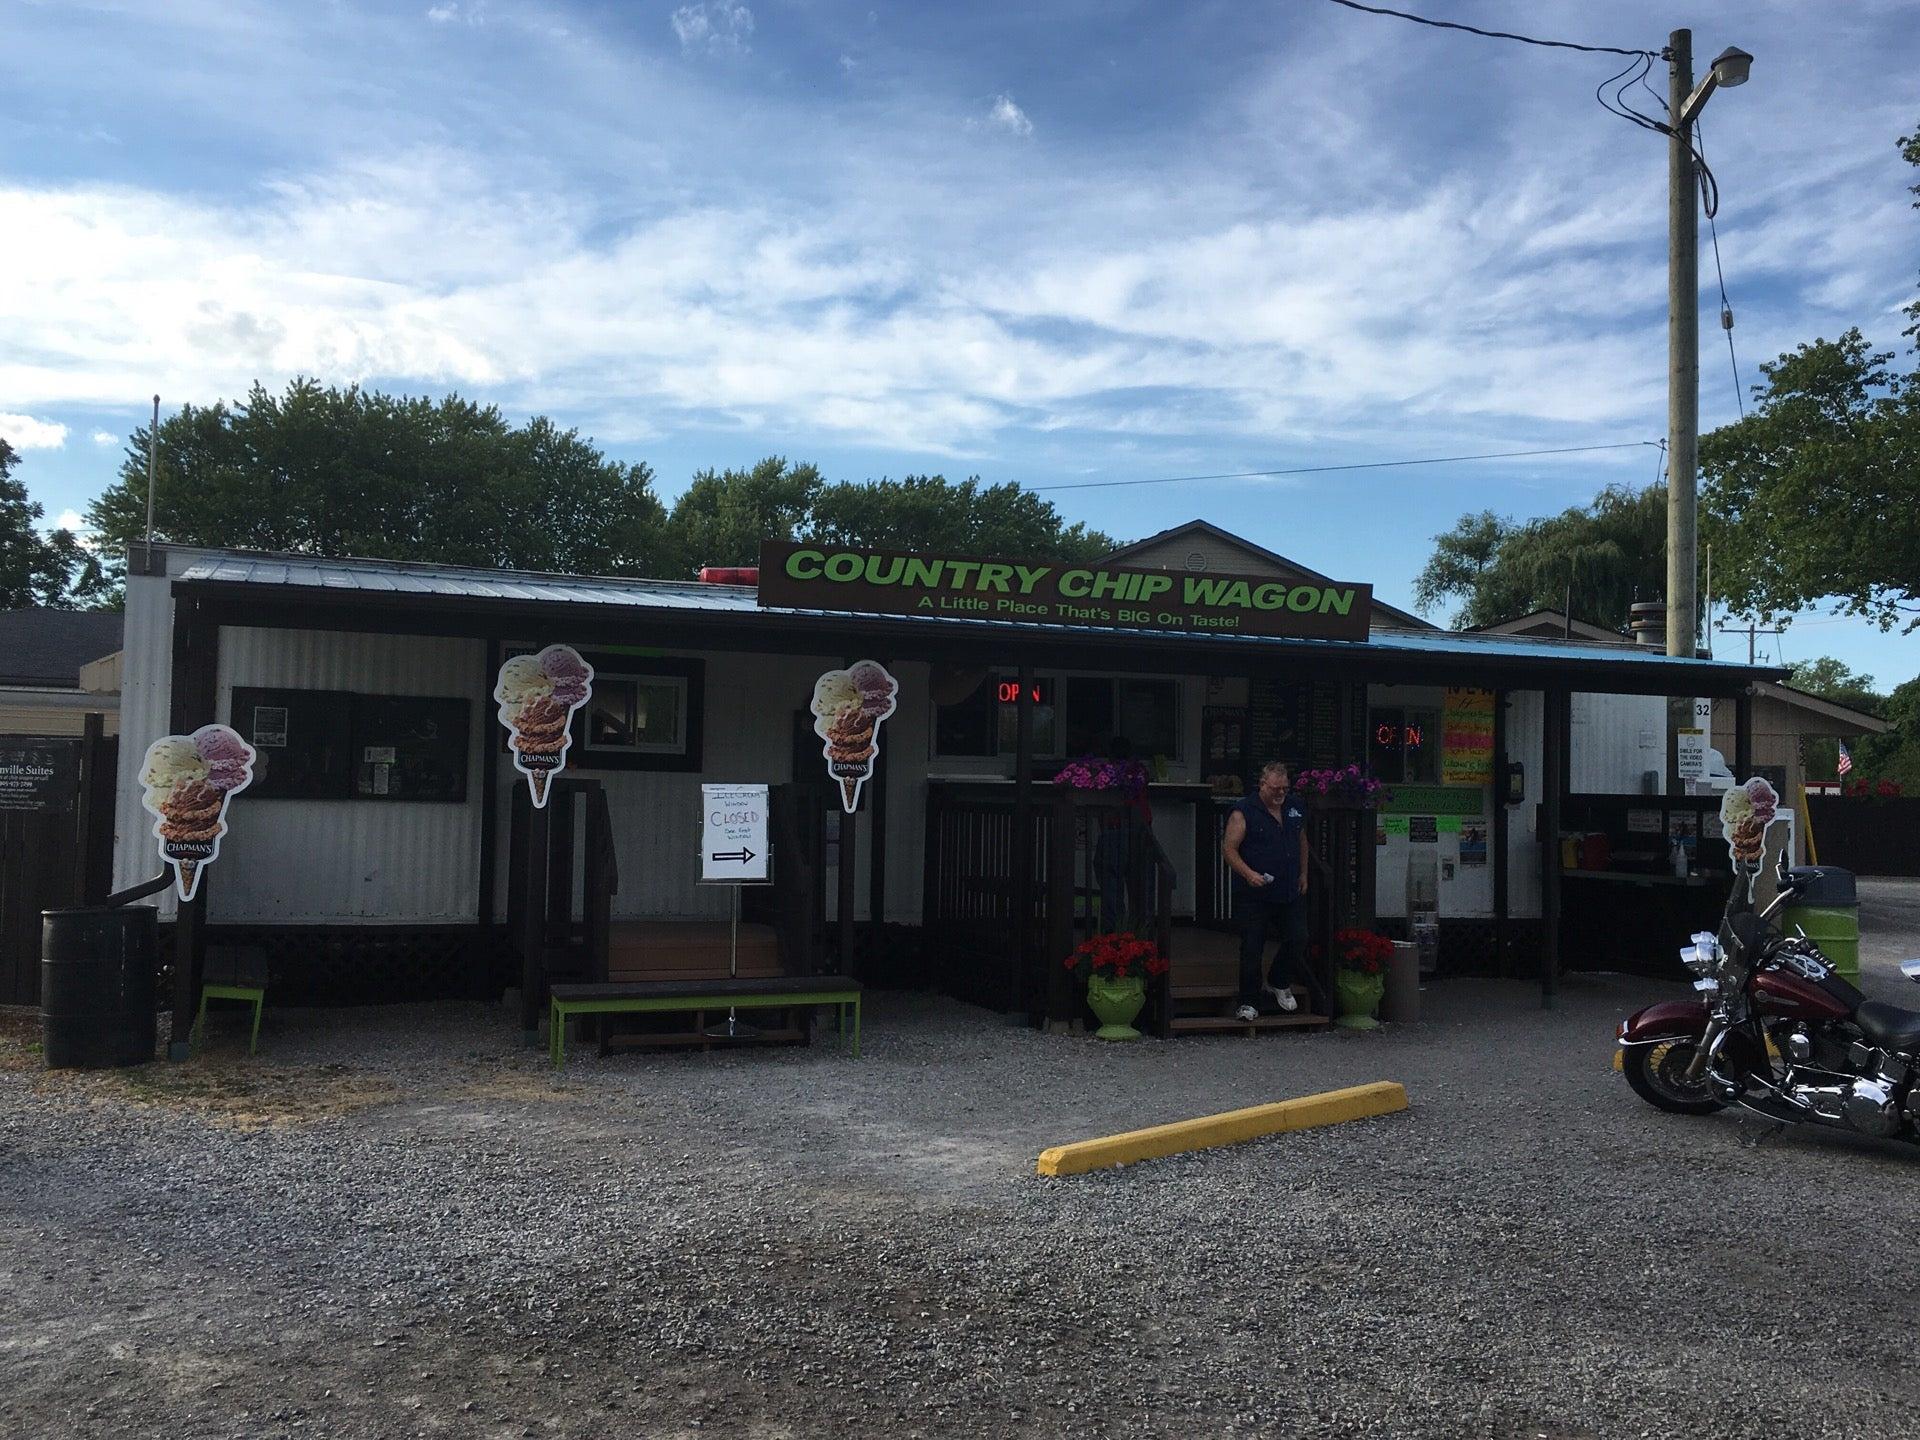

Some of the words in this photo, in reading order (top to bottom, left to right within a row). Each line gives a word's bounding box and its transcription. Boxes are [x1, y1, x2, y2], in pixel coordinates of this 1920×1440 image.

[785, 550, 1051, 595] COUNTRY
[1058, 569, 1172, 602] CHIP
[1183, 576, 1355, 615] WAGON
[918, 597, 934, 608] A
[940, 597, 990, 611] Little
[996, 600, 1048, 615] Place
[1055, 604, 1110, 621] That's
[1118, 609, 1151, 623] BIG
[1157, 612, 1184, 625] On
[1189, 614, 1240, 628] Taste!
[998, 682, 1041, 703] OPN
[1696, 704, 1710, 716] 32
[1377, 725, 1421, 746] OPN
[521, 754, 560, 764] CHAPMAN'S
[0, 765, 24, 775] nville
[25, 764, 55, 775] Suites
[710, 811, 760, 827] CLOSED
[167, 842, 213, 854] CHAPMAN'S
